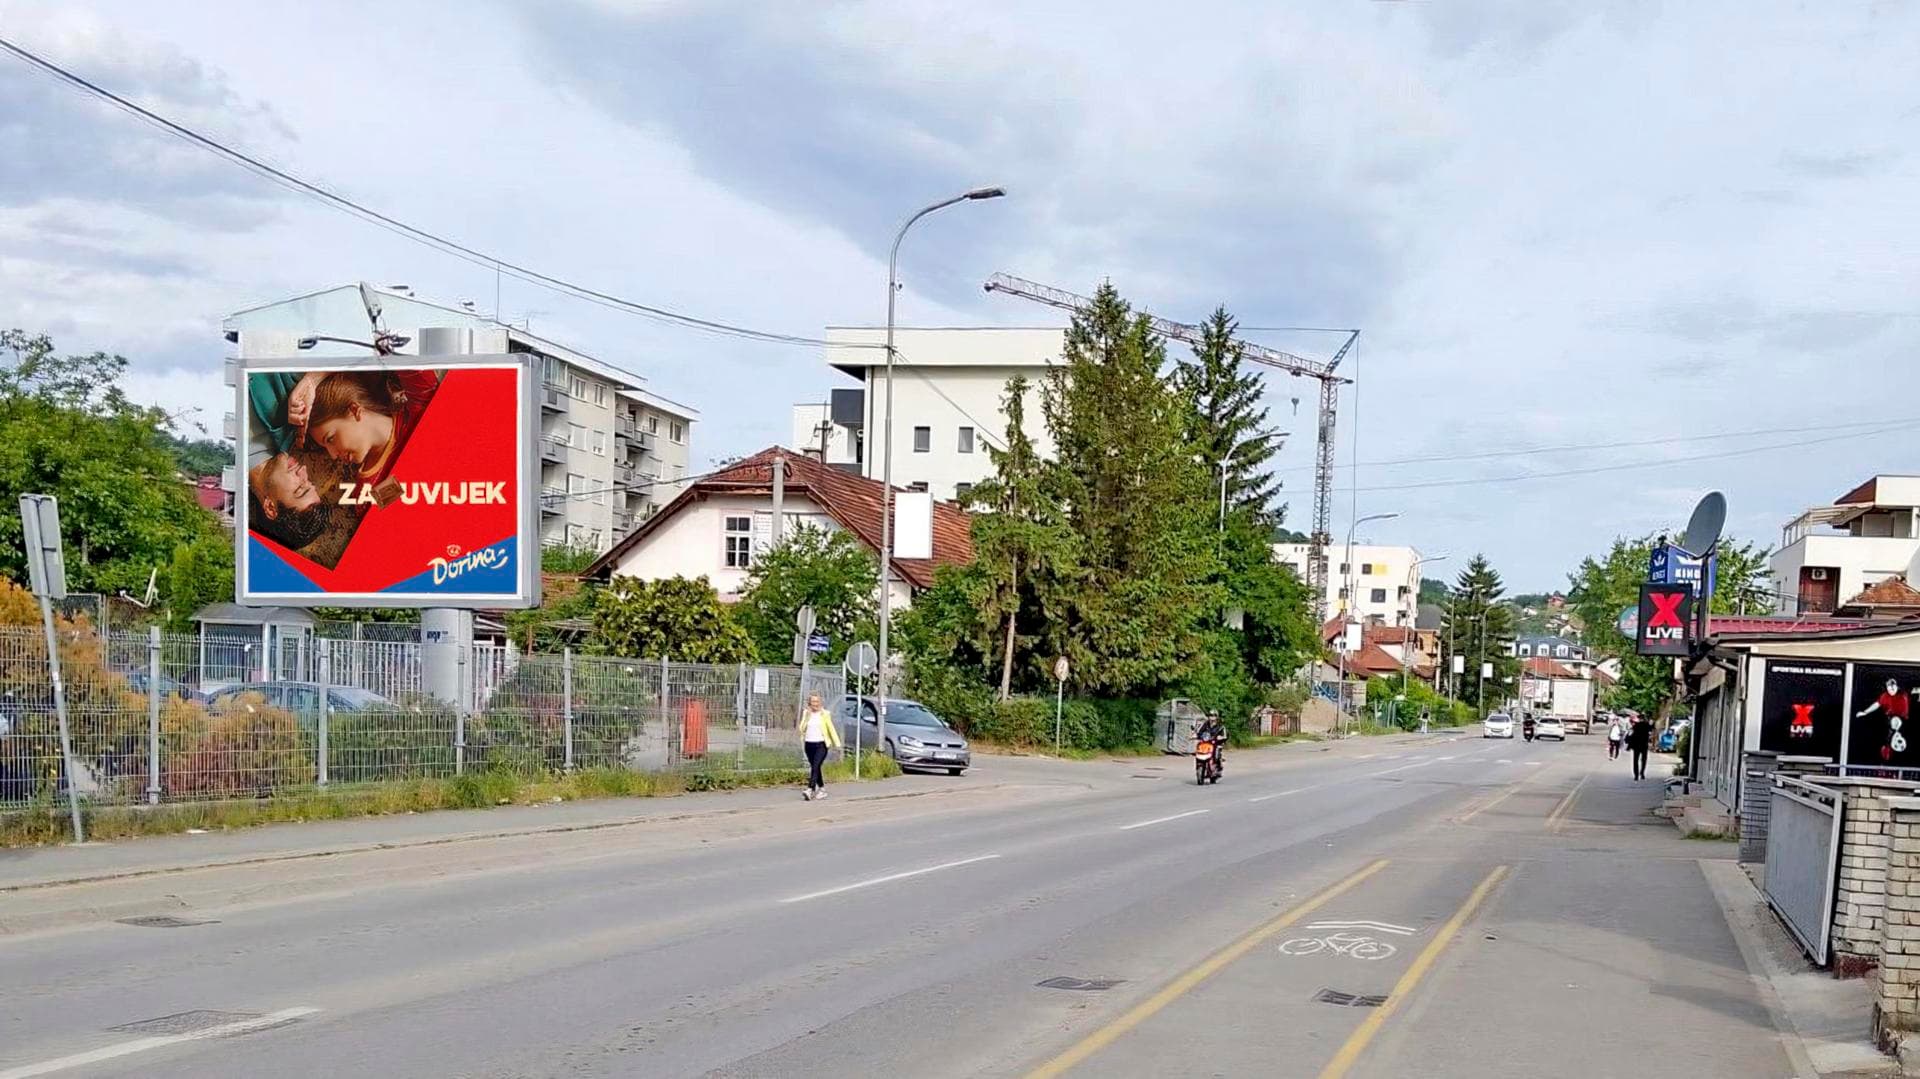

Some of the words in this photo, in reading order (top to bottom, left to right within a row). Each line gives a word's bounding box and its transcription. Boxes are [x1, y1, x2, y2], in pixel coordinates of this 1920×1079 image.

[338, 483, 377, 505] ZA
[401, 482, 507, 505] UVIJEK
[427, 547, 498, 585] Dorina
[1648, 593, 1685, 627] X
[1646, 627, 1684, 639] LIVE
[1792, 704, 1815, 725] X
[1790, 725, 1814, 734] LIVE
